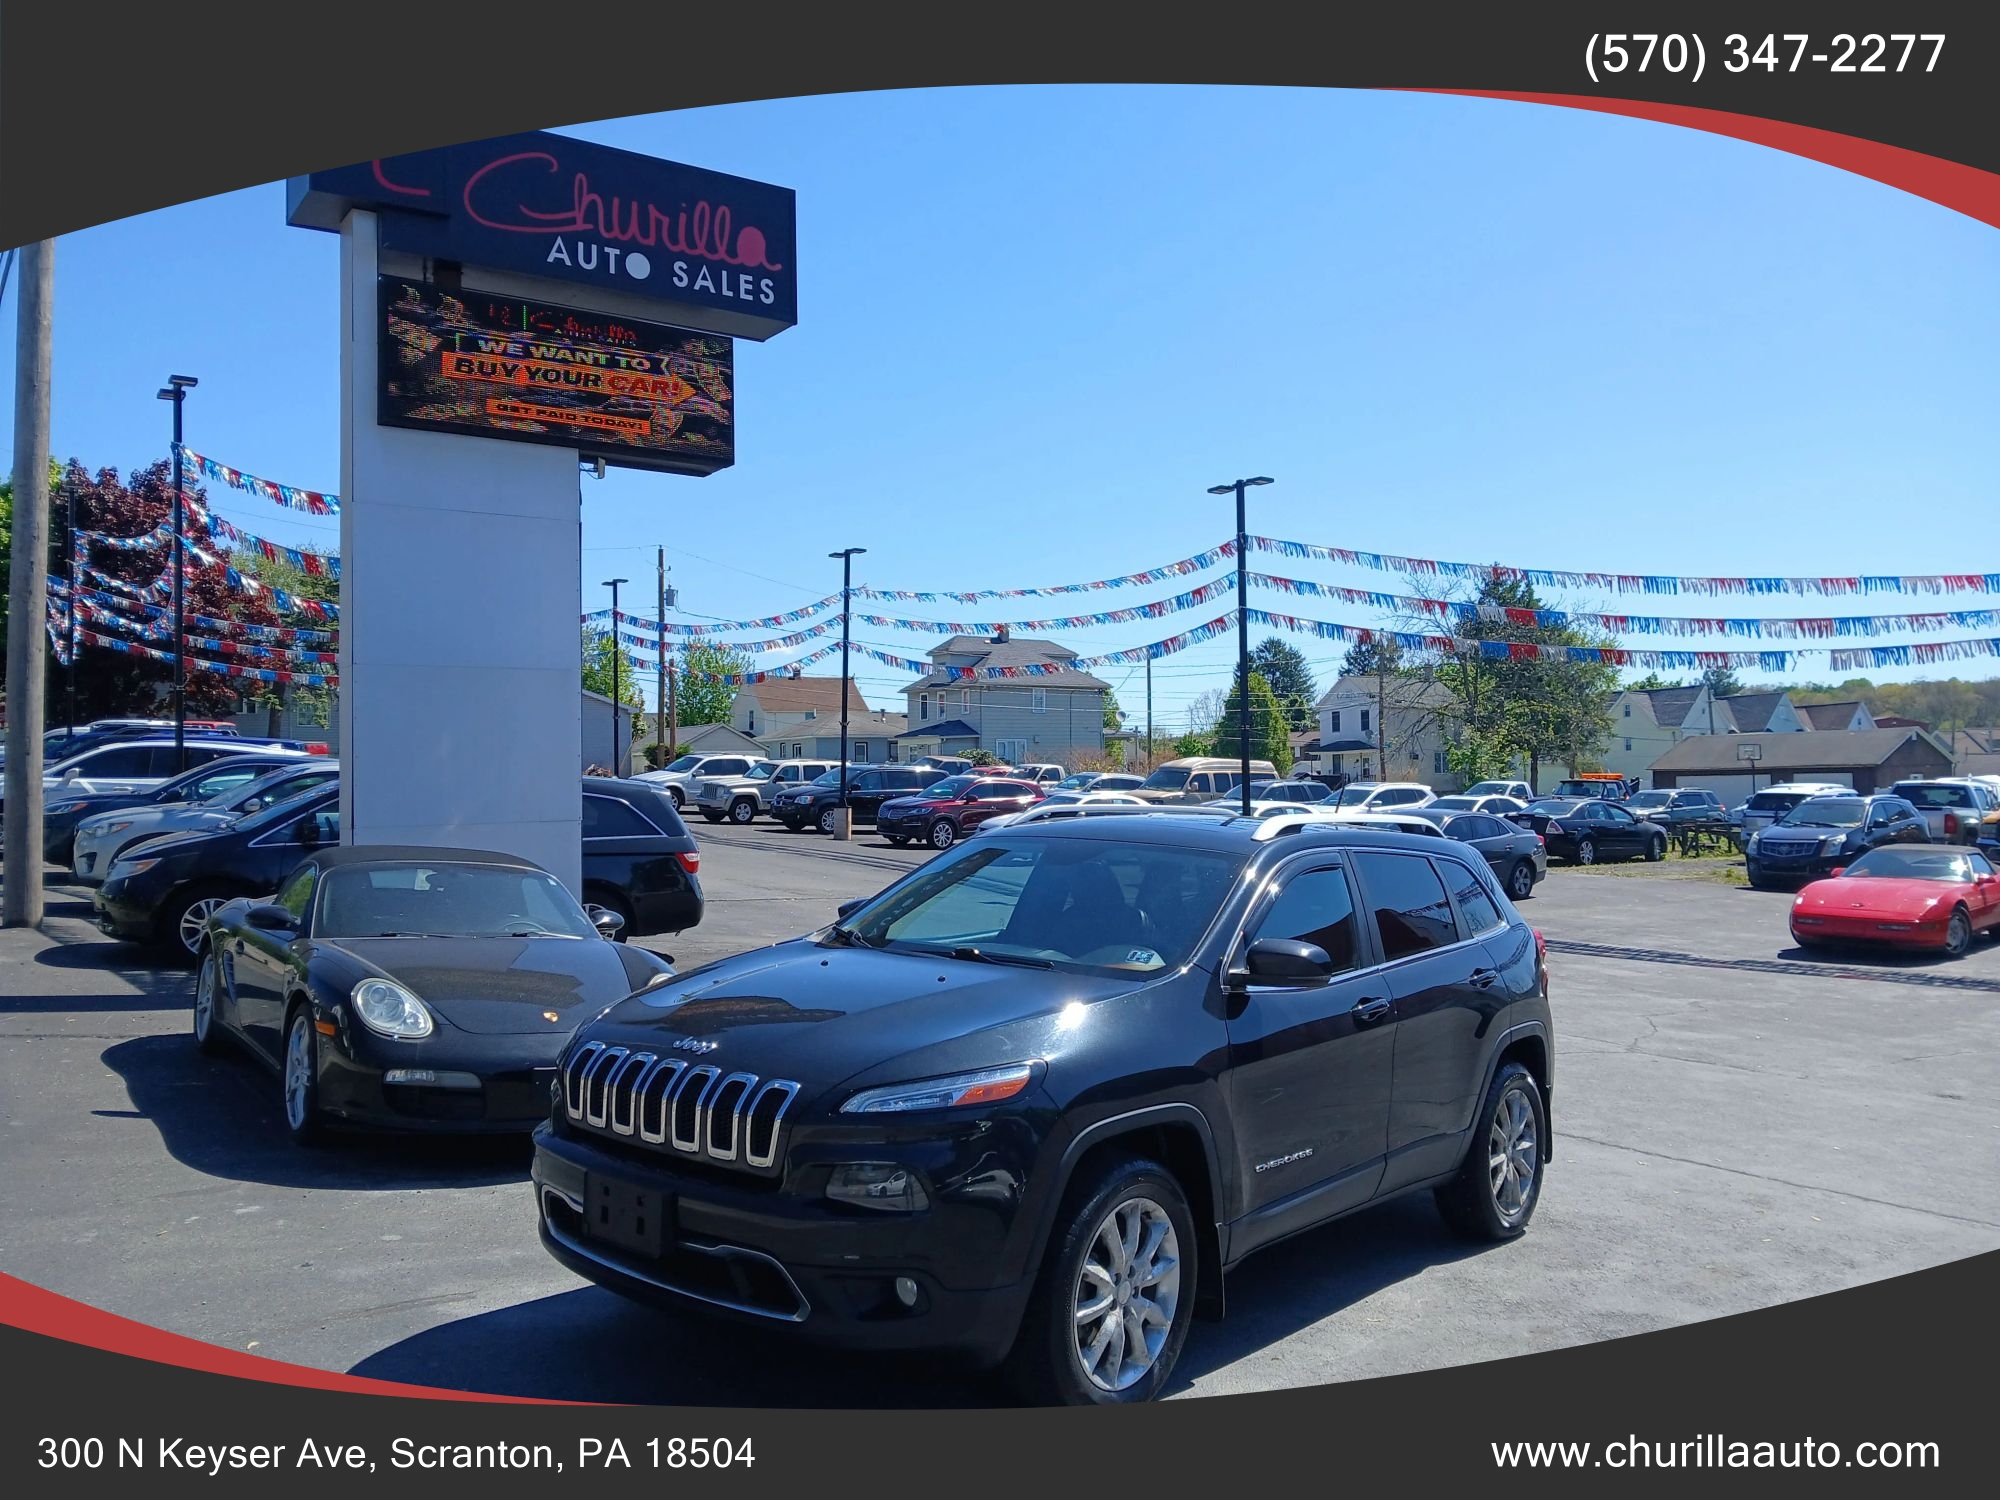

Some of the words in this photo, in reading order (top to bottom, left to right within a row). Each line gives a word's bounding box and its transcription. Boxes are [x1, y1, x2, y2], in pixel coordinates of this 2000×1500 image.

[463, 151, 782, 272] Churilla
[546, 235, 651, 280] AUTO
[672, 261, 776, 305] SALES
[478, 339, 525, 356] WE
[530, 345, 611, 366] WANT
[614, 355, 651, 371] TO
[455, 356, 520, 379] BUY
[524, 363, 602, 389] YOUR
[608, 374, 681, 398] CAR!
[672, 1035, 719, 1056] Jeep
[1255, 1148, 1314, 1173] CHEROKEE
